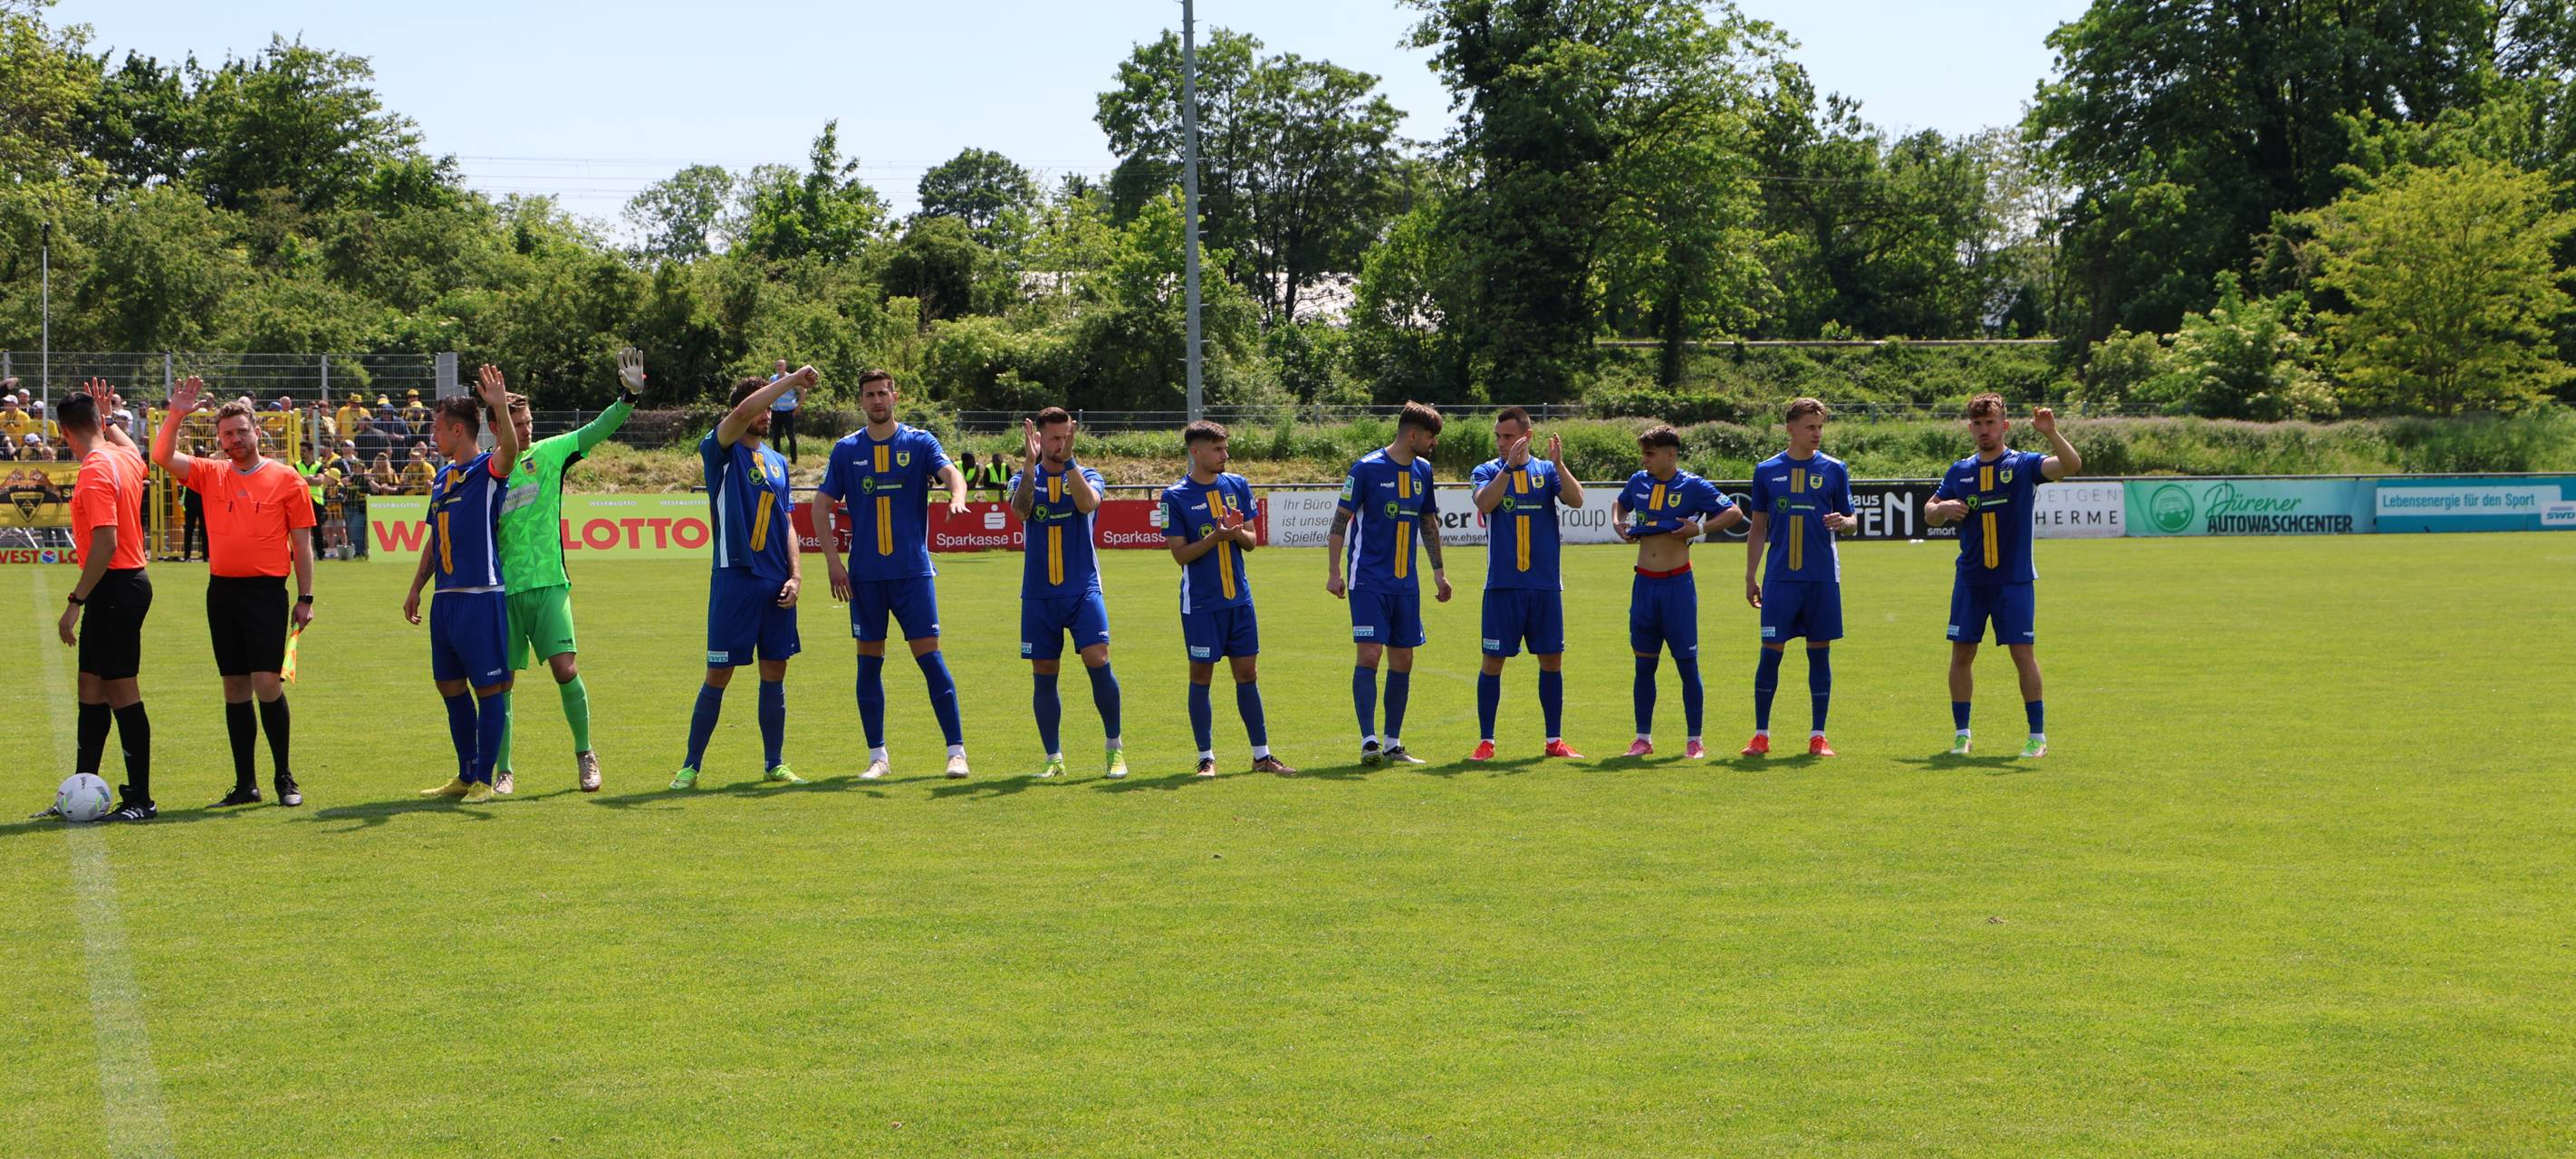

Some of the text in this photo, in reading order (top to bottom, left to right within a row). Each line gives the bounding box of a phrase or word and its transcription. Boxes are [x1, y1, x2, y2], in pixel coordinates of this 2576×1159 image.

[1283, 498, 1332, 510] Ihr Büro
[2383, 493, 2535, 510] Lebensenergie für den Sport
[1282, 515, 1333, 527] ist unser
[1557, 508, 1606, 532] roup
[2207, 514, 2353, 532] AUTOWASCHCENTER
[561, 517, 709, 551] LOTTO
[936, 532, 1009, 546] Sparkasse
[1927, 527, 1956, 536] smart
